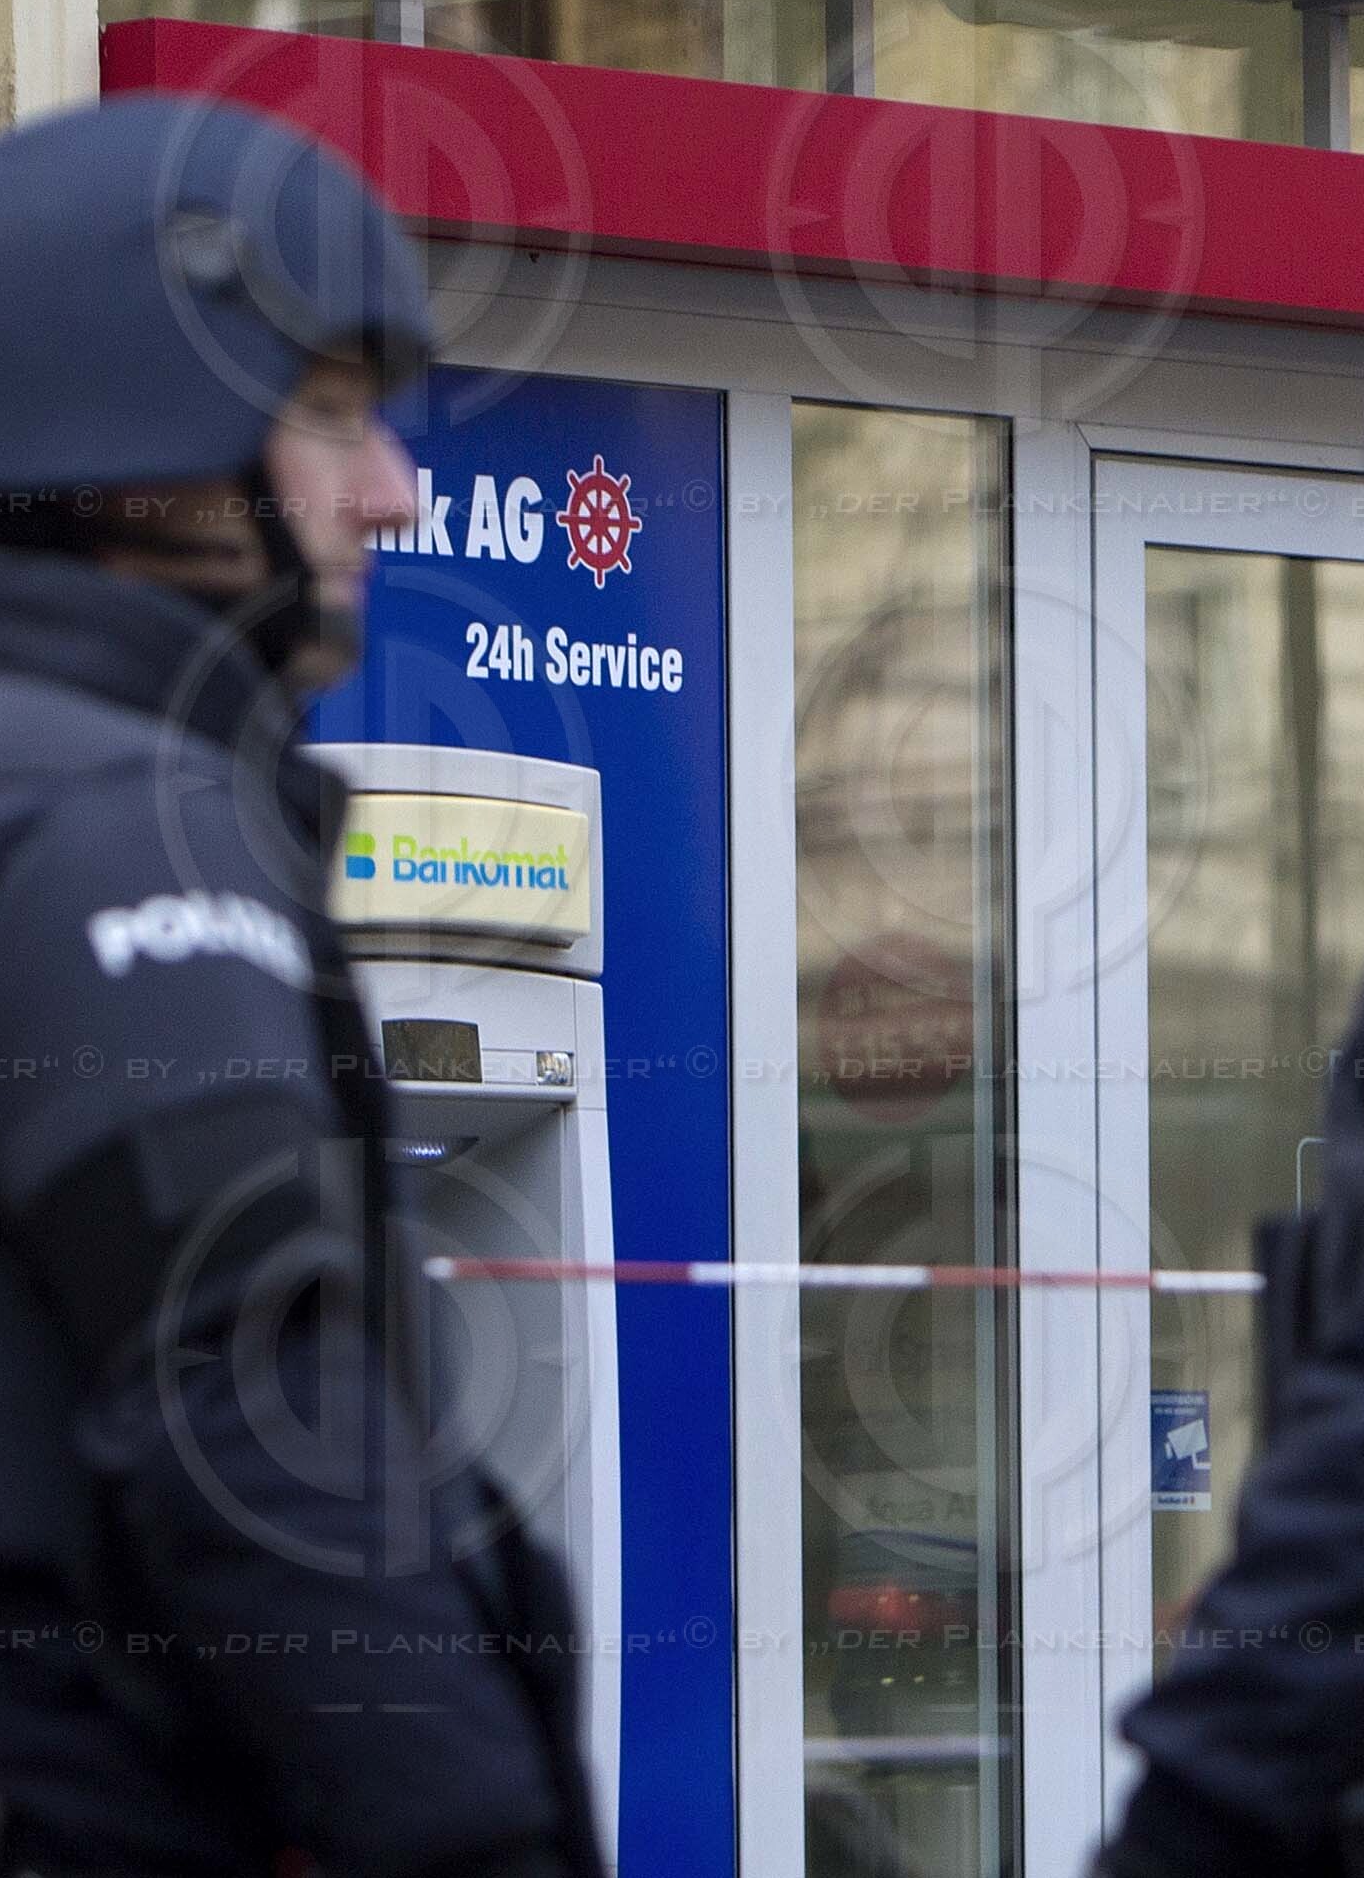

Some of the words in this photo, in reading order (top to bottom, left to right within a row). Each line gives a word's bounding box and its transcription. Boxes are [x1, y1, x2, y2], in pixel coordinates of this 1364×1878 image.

[466, 474, 545, 564] AG
[466, 622, 535, 682] 24h
[545, 626, 684, 693] Service
[391, 835, 570, 891] Bankomat
